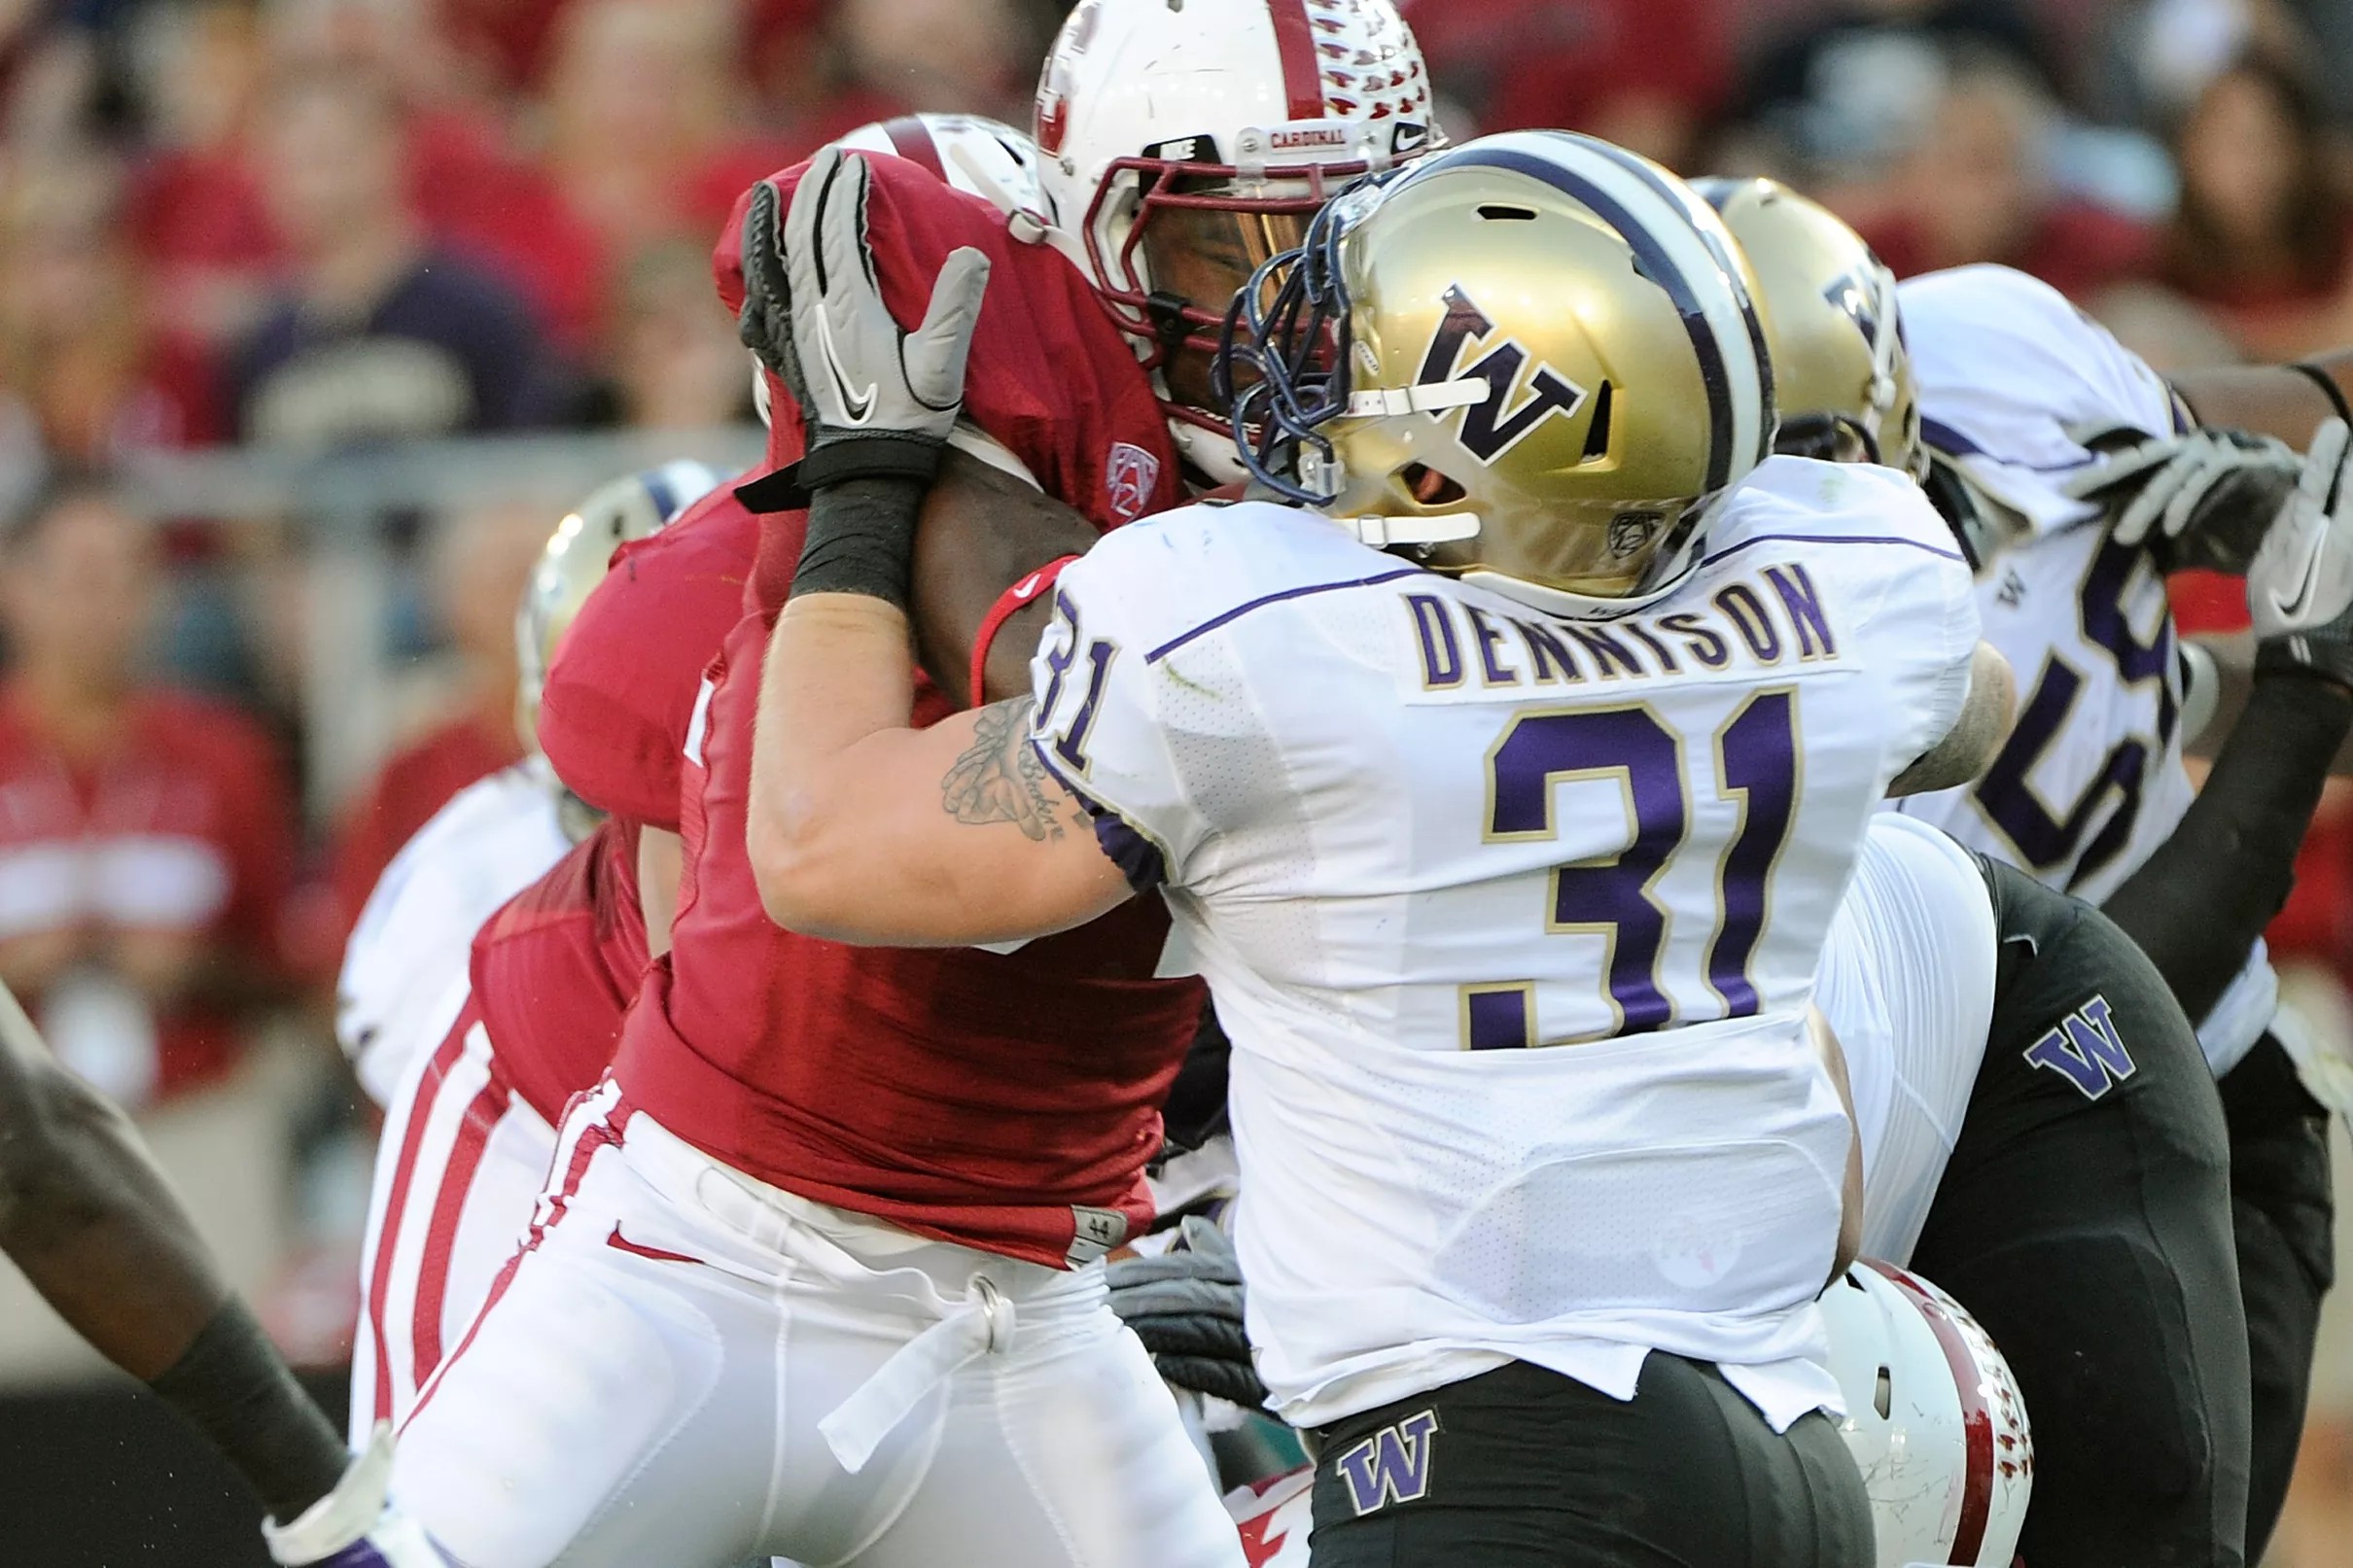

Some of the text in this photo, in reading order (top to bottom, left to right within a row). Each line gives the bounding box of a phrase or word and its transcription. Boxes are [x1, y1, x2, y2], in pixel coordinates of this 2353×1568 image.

[1271, 128, 1346, 149] CARDINAL
[1413, 281, 1588, 467] W
[1033, 587, 1122, 777] 31
[1400, 563, 1840, 691] DENNISON
[1459, 683, 1804, 1050] 31
[2022, 993, 2136, 1100] W
[1336, 1409, 1438, 1516] W
